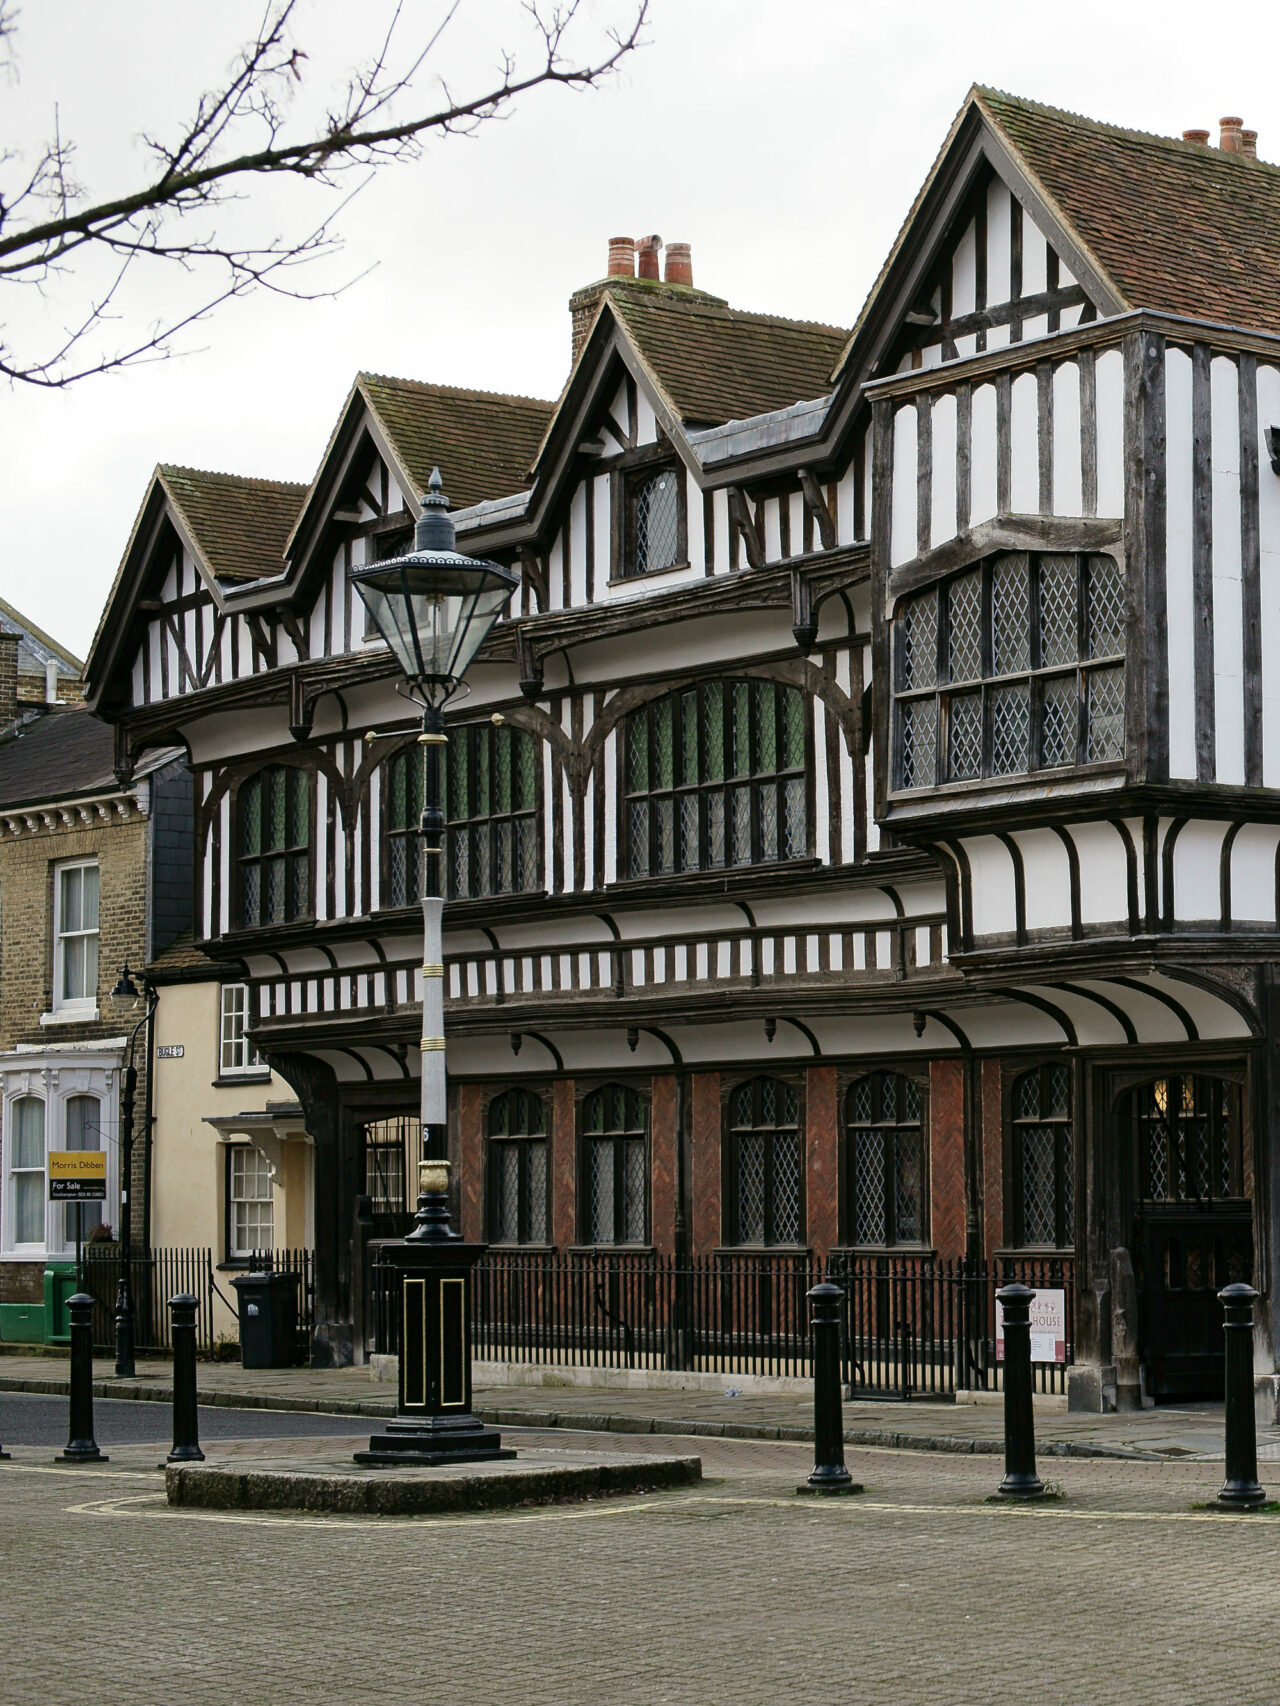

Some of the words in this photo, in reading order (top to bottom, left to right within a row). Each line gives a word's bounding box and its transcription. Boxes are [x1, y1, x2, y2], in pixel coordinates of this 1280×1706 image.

[52, 1161, 77, 1169] Morris
[79, 1161, 104, 1169] Dibben
[52, 1181, 65, 1190] For
[66, 1181, 81, 1190] Sale
[1032, 1316, 1061, 1327] HOUSE
